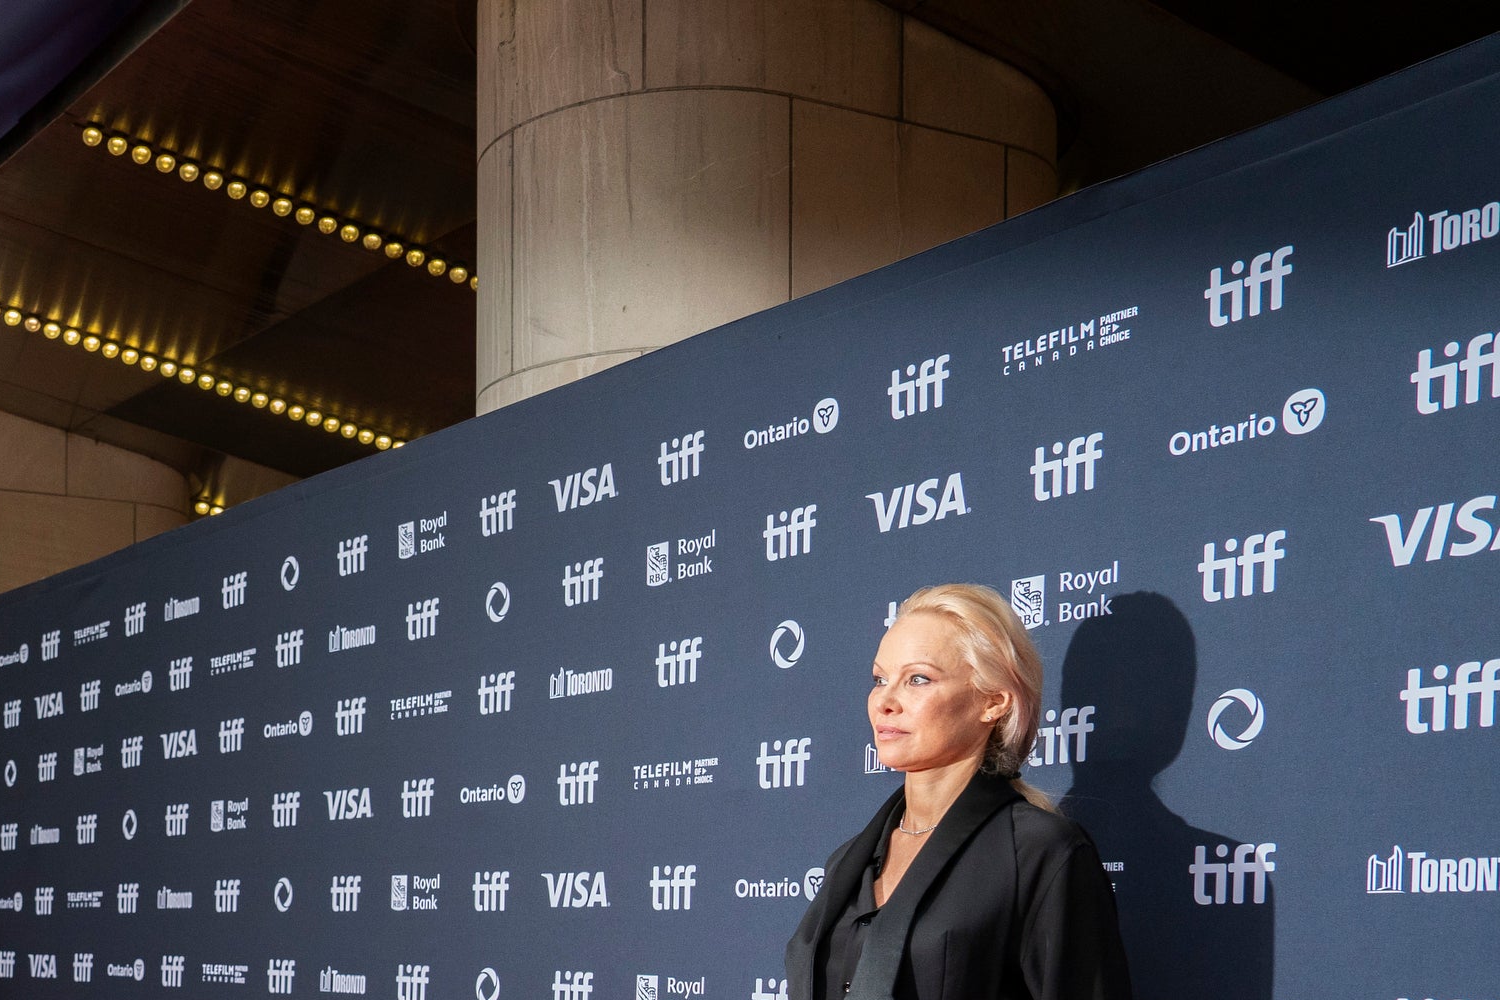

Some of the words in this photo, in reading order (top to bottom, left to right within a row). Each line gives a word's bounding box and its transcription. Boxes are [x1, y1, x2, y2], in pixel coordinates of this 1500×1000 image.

[1429, 201, 1500, 254] TORO
[1204, 246, 1293, 327] tiff
[1100, 306, 1138, 326] PARTNER
[1100, 325, 1111, 337] OF
[1002, 319, 1095, 363] TELEFILM
[1100, 329, 1130, 347] CHOICE
[1004, 340, 1094, 375] CANADA
[1410, 332, 1500, 415] tif
[888, 354, 949, 419] tiff
[744, 417, 809, 449] Ontario
[1169, 414, 1275, 455] Ontario
[658, 430, 704, 485] tiff
[1030, 432, 1103, 501] tiff
[548, 463, 615, 512] VISA
[865, 473, 966, 532] VISA
[420, 511, 446, 533] Royal
[480, 489, 516, 537] tiff
[421, 533, 445, 553] Bank
[678, 529, 715, 556] Royal
[763, 504, 816, 561] tiff
[1369, 495, 1500, 567] VIS
[562, 558, 603, 606] tiff
[678, 556, 712, 579] Bank
[1059, 561, 1119, 594] Royal
[1198, 530, 1285, 602] tiff
[222, 572, 247, 609] tiff
[125, 602, 146, 637] tiff
[173, 597, 199, 619] TORONTO
[406, 598, 439, 640] tiff
[1058, 594, 1112, 623] Bank
[41, 630, 60, 661] tiff
[341, 625, 375, 650] TORONTO
[656, 637, 702, 687] tiff
[80, 680, 100, 712] tiff
[115, 680, 141, 696] Ontario
[566, 668, 612, 696] TORONTO
[1400, 659, 1500, 734] tiff
[34, 692, 63, 719] VISA
[335, 697, 366, 736] tiff
[160, 729, 197, 759] VISA
[219, 718, 244, 753] tiff
[264, 720, 297, 738] Ontario
[633, 760, 692, 780] TELEFILM
[694, 757, 718, 768] PARTNER
[756, 738, 811, 789] tiff
[401, 778, 434, 818] tiff
[460, 784, 505, 803] Ontario
[633, 776, 691, 790] CANADA
[323, 788, 373, 820] VISA
[0, 823, 18, 851] tiff
[414, 874, 440, 893] Royal
[650, 865, 696, 910] tiff
[735, 878, 800, 897] Ontario
[1189, 843, 1276, 905] tiff
[1407, 852, 1500, 893] TORON
[413, 895, 437, 909] Bank
[541, 872, 607, 907] VISA
[28, 954, 56, 978] VISA
[332, 970, 366, 994] TORONTO
[667, 976, 705, 999] Royal
